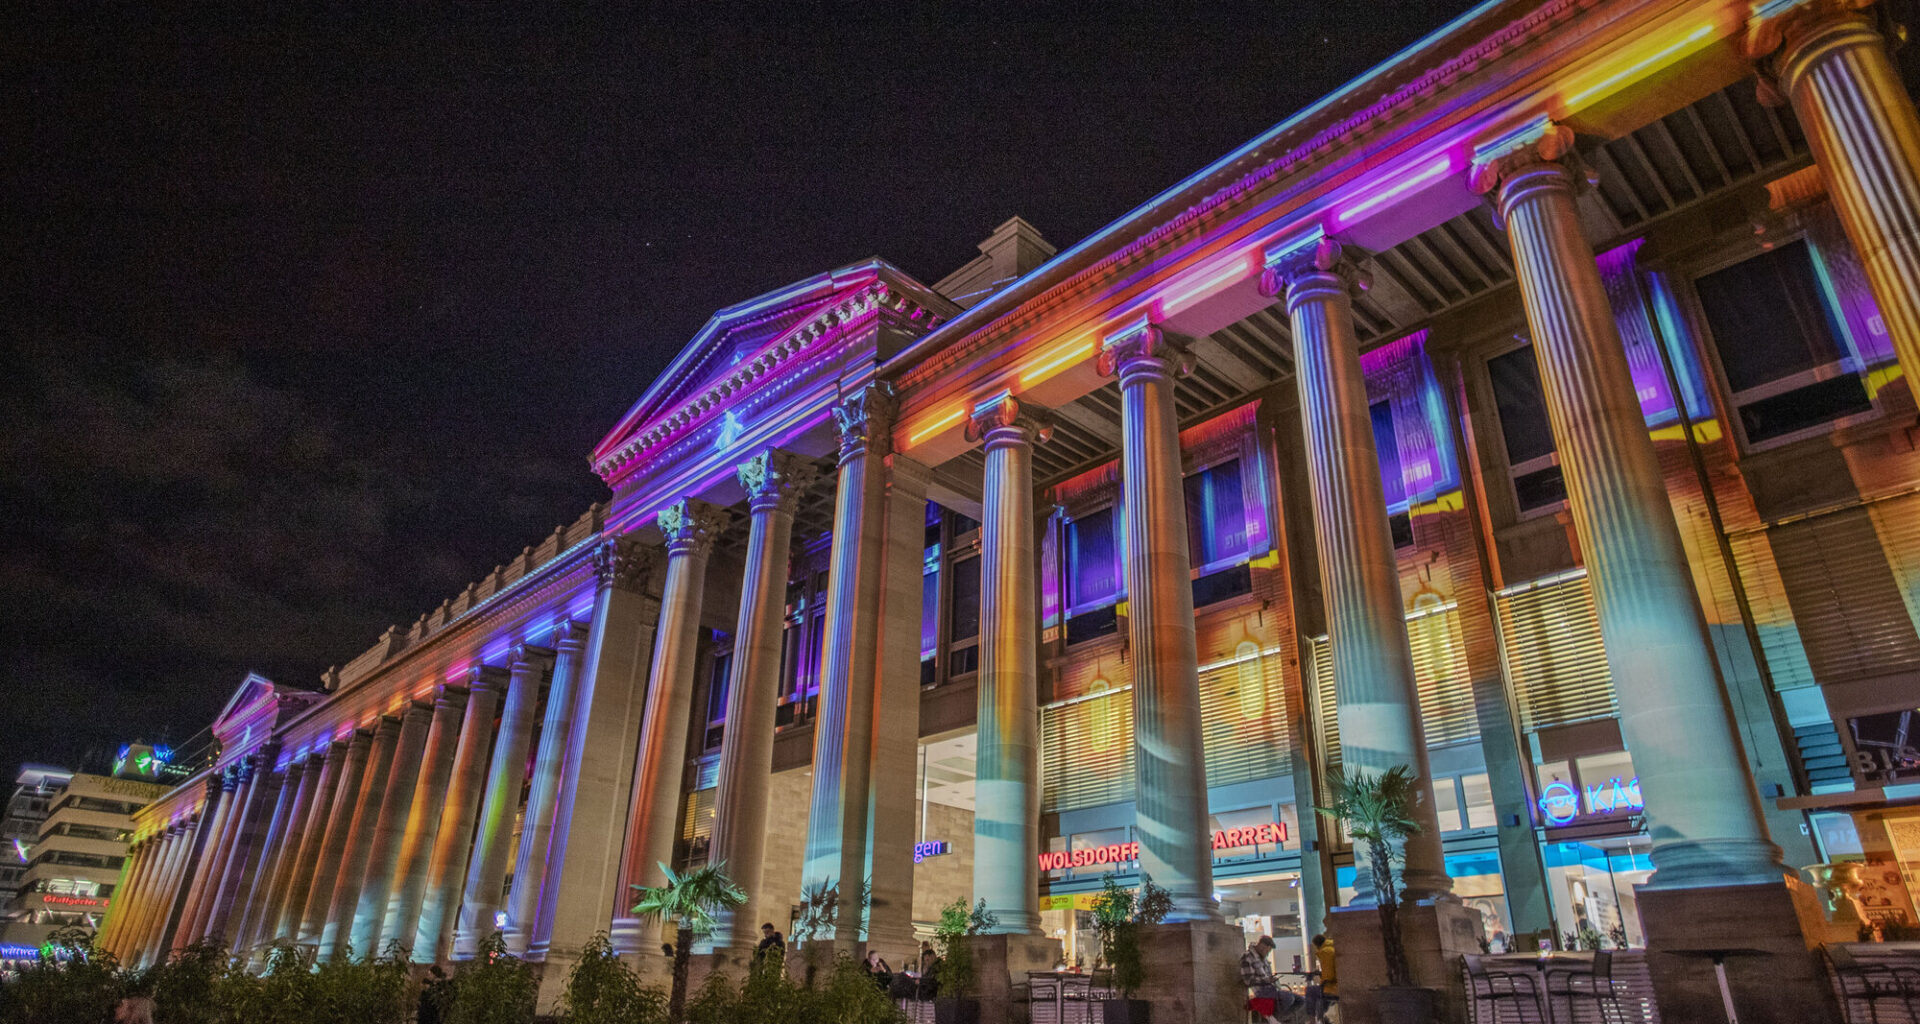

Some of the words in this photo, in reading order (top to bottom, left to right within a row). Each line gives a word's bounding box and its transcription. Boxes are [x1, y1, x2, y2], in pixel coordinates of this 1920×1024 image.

[1586, 777, 1644, 813] KÄS
[913, 840, 942, 864] gen
[1038, 841, 1140, 872] WOLSDORFF
[1051, 897, 1069, 905] LOTTO
[0, 945, 39, 957] wittwer
